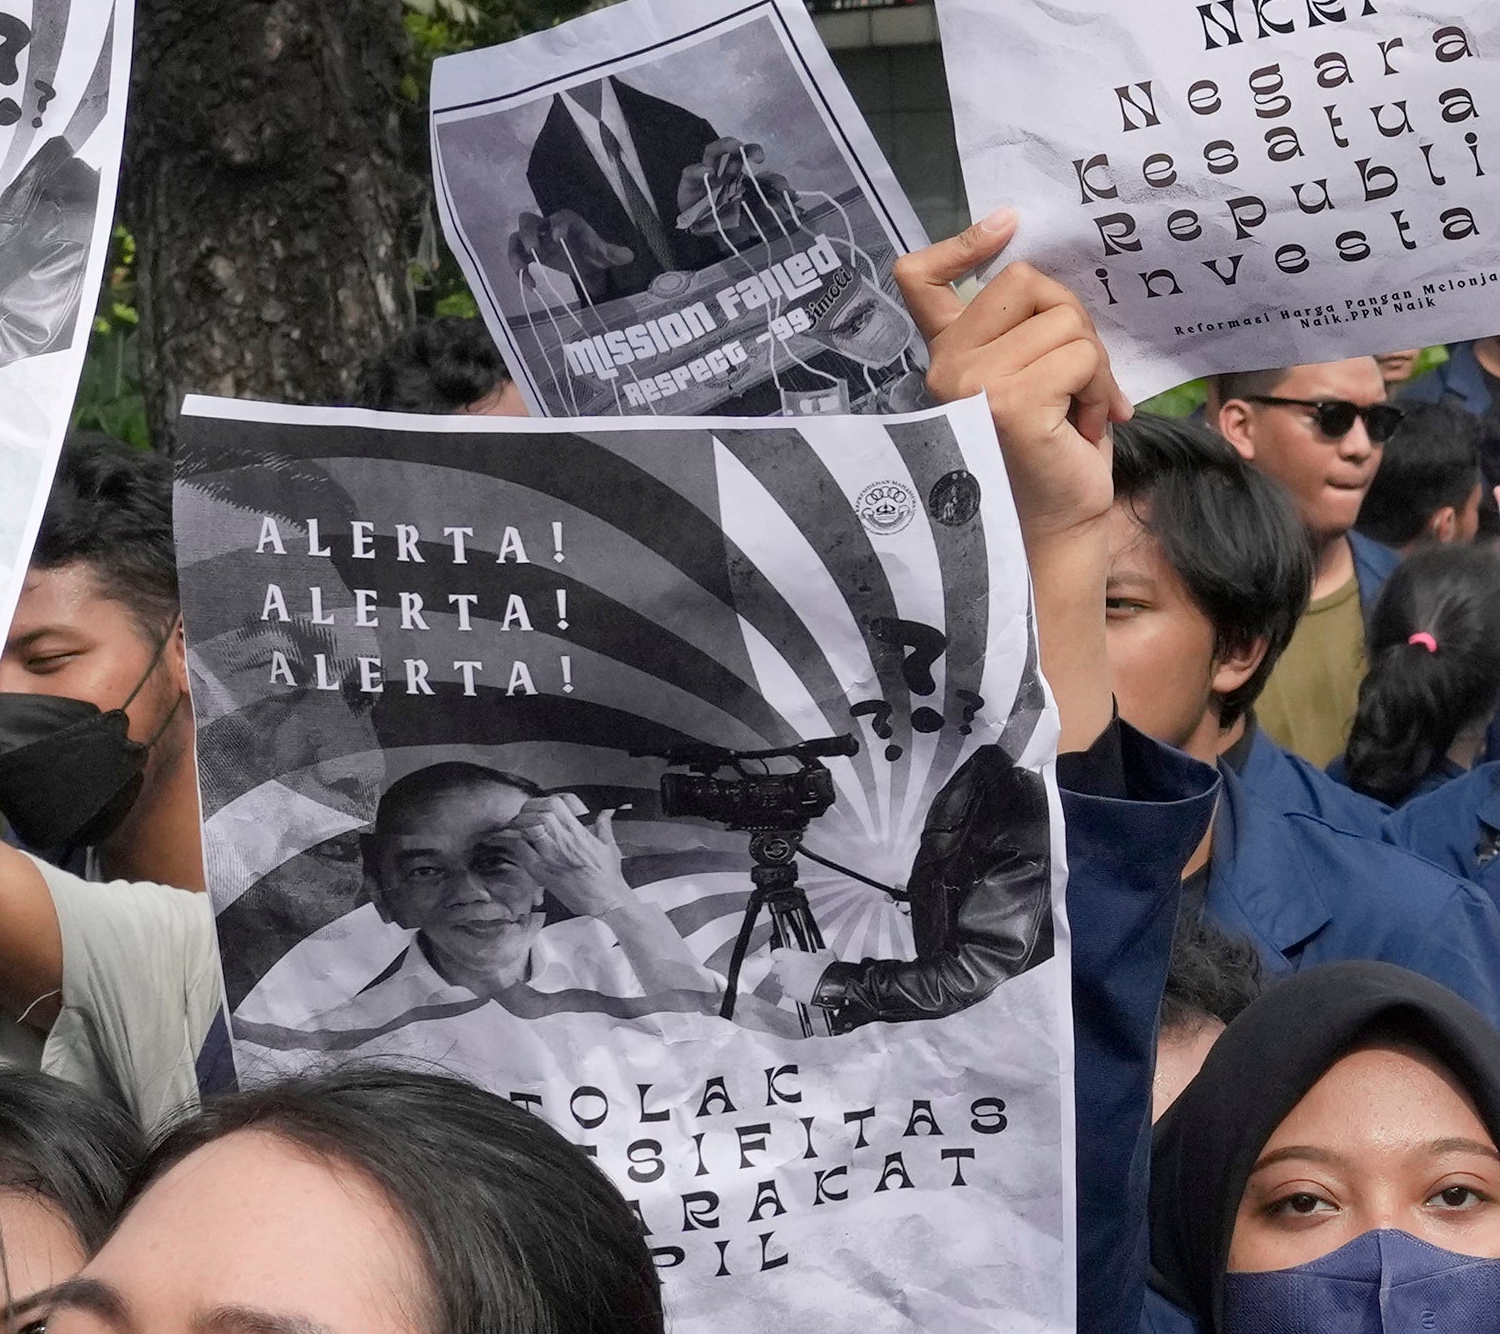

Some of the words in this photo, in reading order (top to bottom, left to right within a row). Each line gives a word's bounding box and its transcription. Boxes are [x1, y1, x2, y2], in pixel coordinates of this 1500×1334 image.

[1112, 24, 1474, 133] Negara
[1174, 312, 1271, 336] Reformasi
[1280, 302, 1336, 322] Harga
[1345, 288, 1413, 311] Pangan
[1300, 306, 1384, 330] Naik.PPN
[1395, 297, 1437, 313] Naik
[255, 517, 566, 566] ALERTA!
[260, 582, 572, 633] ALERTA!
[268, 653, 576, 698] ALERTA!
[592, 1097, 1008, 1184] SIFITAS
